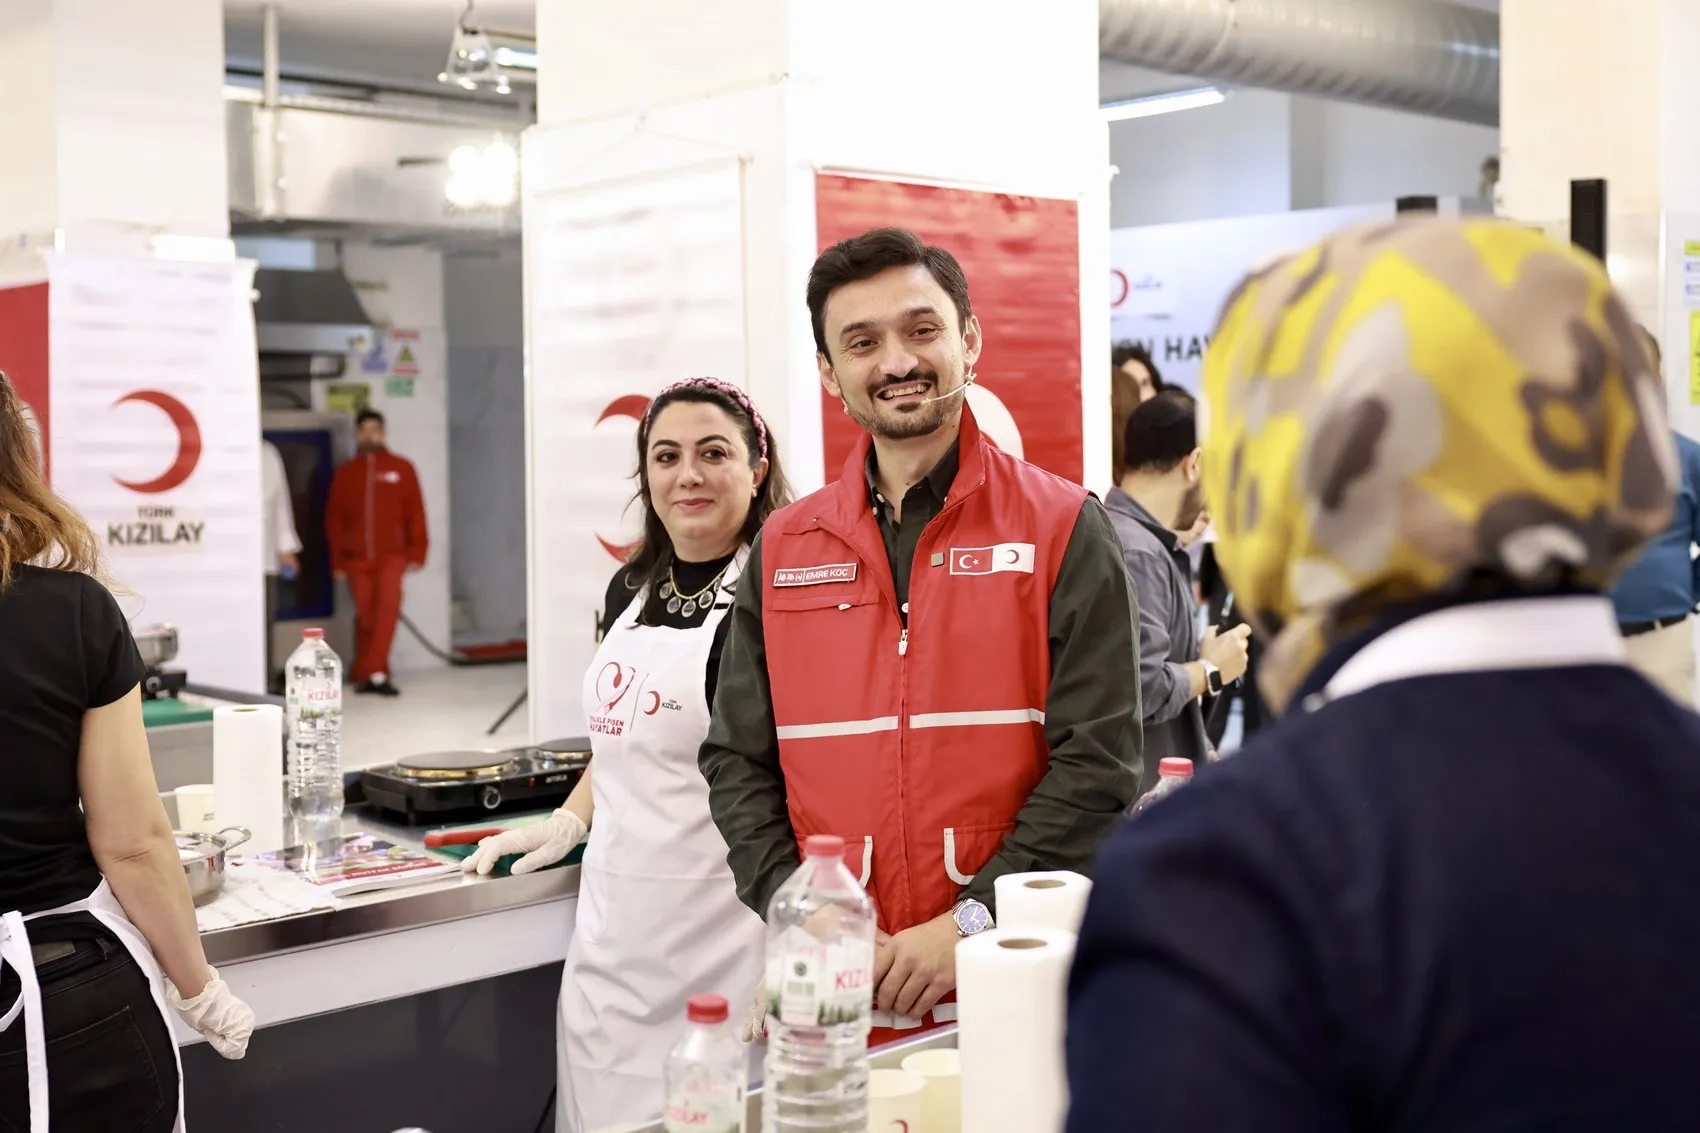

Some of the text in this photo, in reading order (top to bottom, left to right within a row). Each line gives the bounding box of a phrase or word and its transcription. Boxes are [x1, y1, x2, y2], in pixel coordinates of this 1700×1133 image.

[107, 521, 204, 545] KIZILAY
[805, 569, 829, 580] EMRE
[829, 568, 849, 578] KOÇ
